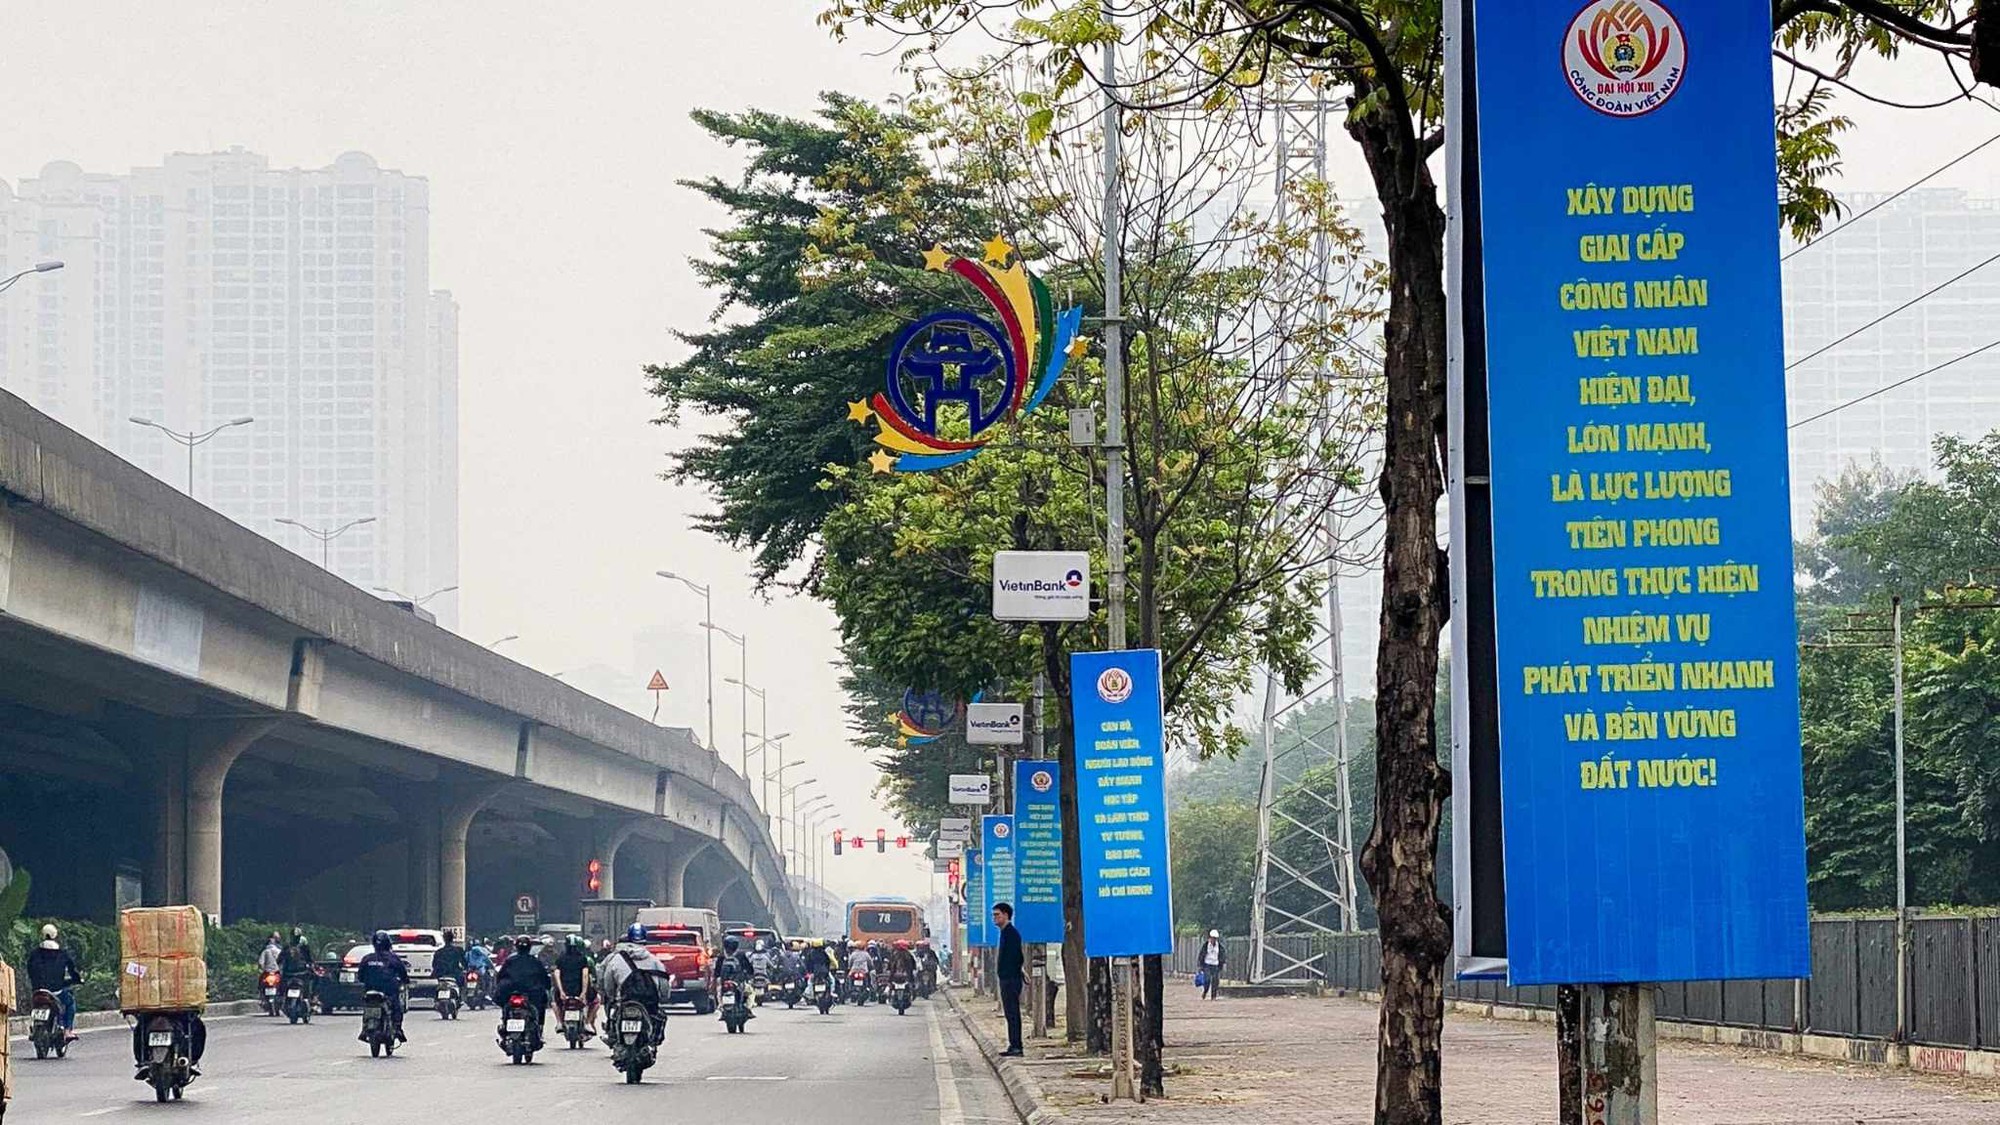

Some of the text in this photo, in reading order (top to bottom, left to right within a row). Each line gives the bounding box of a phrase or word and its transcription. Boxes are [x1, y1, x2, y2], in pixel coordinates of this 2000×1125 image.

[1570, 66, 1680, 112] CÔNG ĐOÀN VIỆT NAM
[1597, 80, 1654, 96] ĐẠI HỘI XIII
[1567, 183, 1694, 218] XÂY DỰNG
[1580, 223, 1685, 262] GIAI CẤP
[1561, 275, 1707, 310] CÔNG NHÂN
[1574, 324, 1698, 362] VIỆT NAM
[1580, 372, 1696, 409] HIỆN ĐẠI,
[1567, 421, 1712, 455] LỚN MẠNH,
[1551, 468, 1731, 505] LÀ LỰC LƯỢNG
[1566, 516, 1720, 549] TIÊN PHONG
[999, 580, 1066, 591] VietinBank
[1531, 559, 1759, 599] TRONG THỰC HIỆN
[1583, 610, 1711, 648] NHIỆM VỤ
[1523, 651, 1775, 695] PHÁT TRIỂN NHANH
[970, 720, 1010, 728] VietinBank
[1564, 701, 1737, 741] VÀ BỀN VỮNG
[1581, 751, 1718, 789] ĐẤT NƯỚC!
[878, 913, 891, 923] 78
